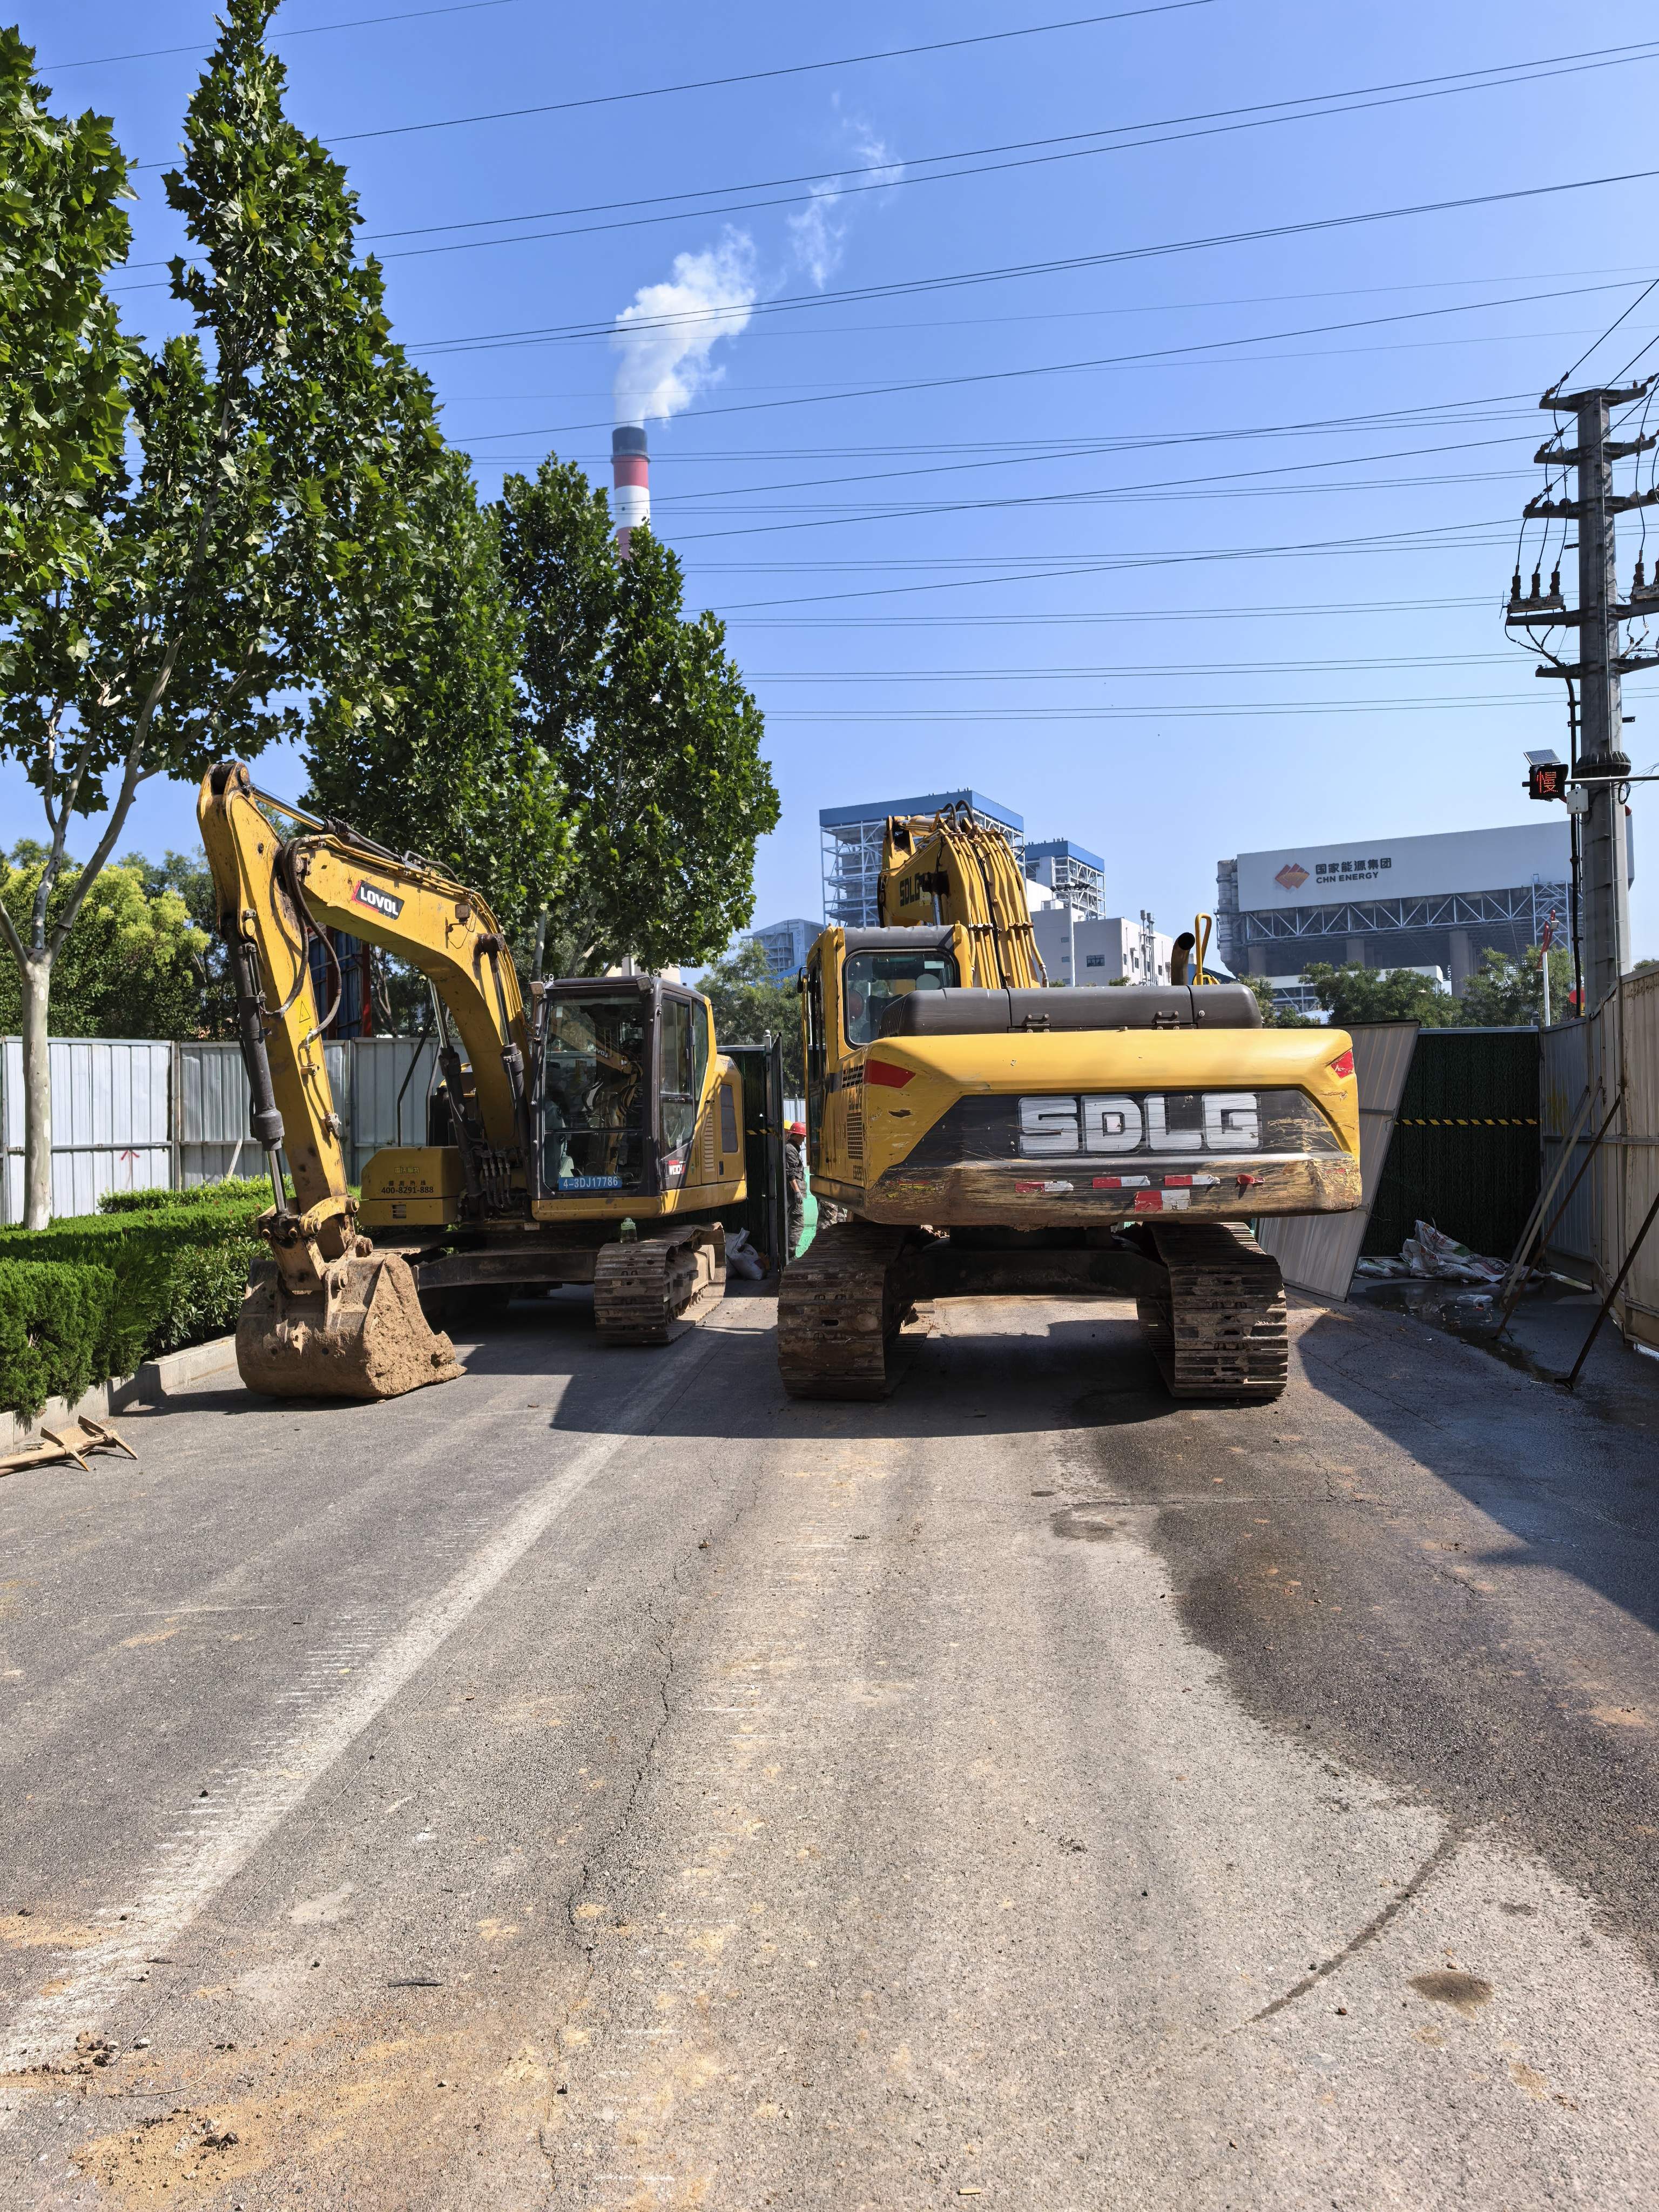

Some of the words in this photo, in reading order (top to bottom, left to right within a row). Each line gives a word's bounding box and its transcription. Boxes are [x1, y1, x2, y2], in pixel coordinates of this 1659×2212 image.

[1536, 771, 1558, 793] 慢
[1316, 858, 1392, 875] 国家能源集团
[1316, 875, 1336, 884] CHN
[1339, 871, 1379, 882] ENERGY
[360, 886, 399, 916] LOVOL
[1018, 1091, 1261, 1155] SDLG
[563, 1176, 618, 1189] 4-3DJ17786
